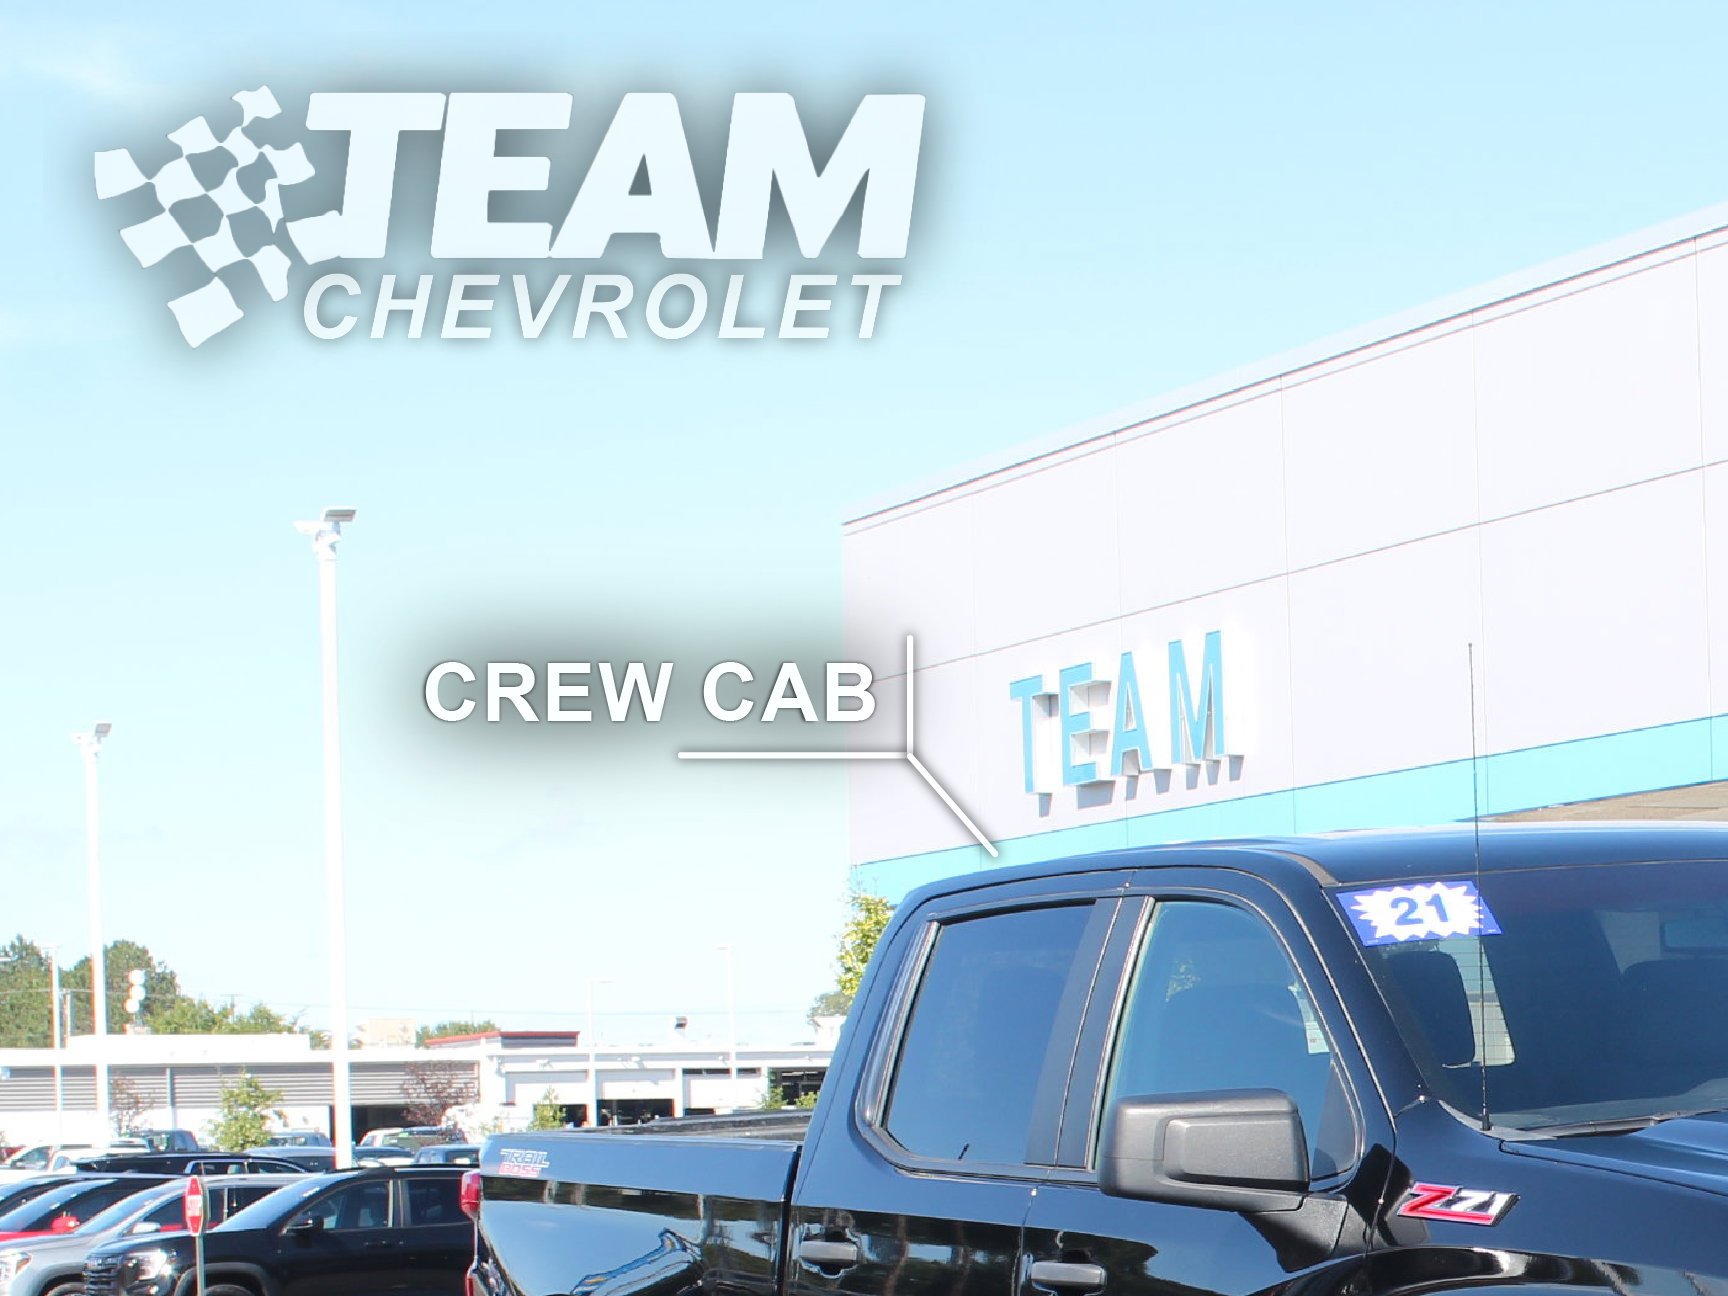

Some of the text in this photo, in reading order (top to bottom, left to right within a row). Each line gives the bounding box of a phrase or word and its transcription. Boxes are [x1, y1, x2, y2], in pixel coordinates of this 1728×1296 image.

[1010, 630, 1226, 794] TEAM
[1390, 894, 1449, 926] 21
[1396, 1182, 1518, 1226] Z71
